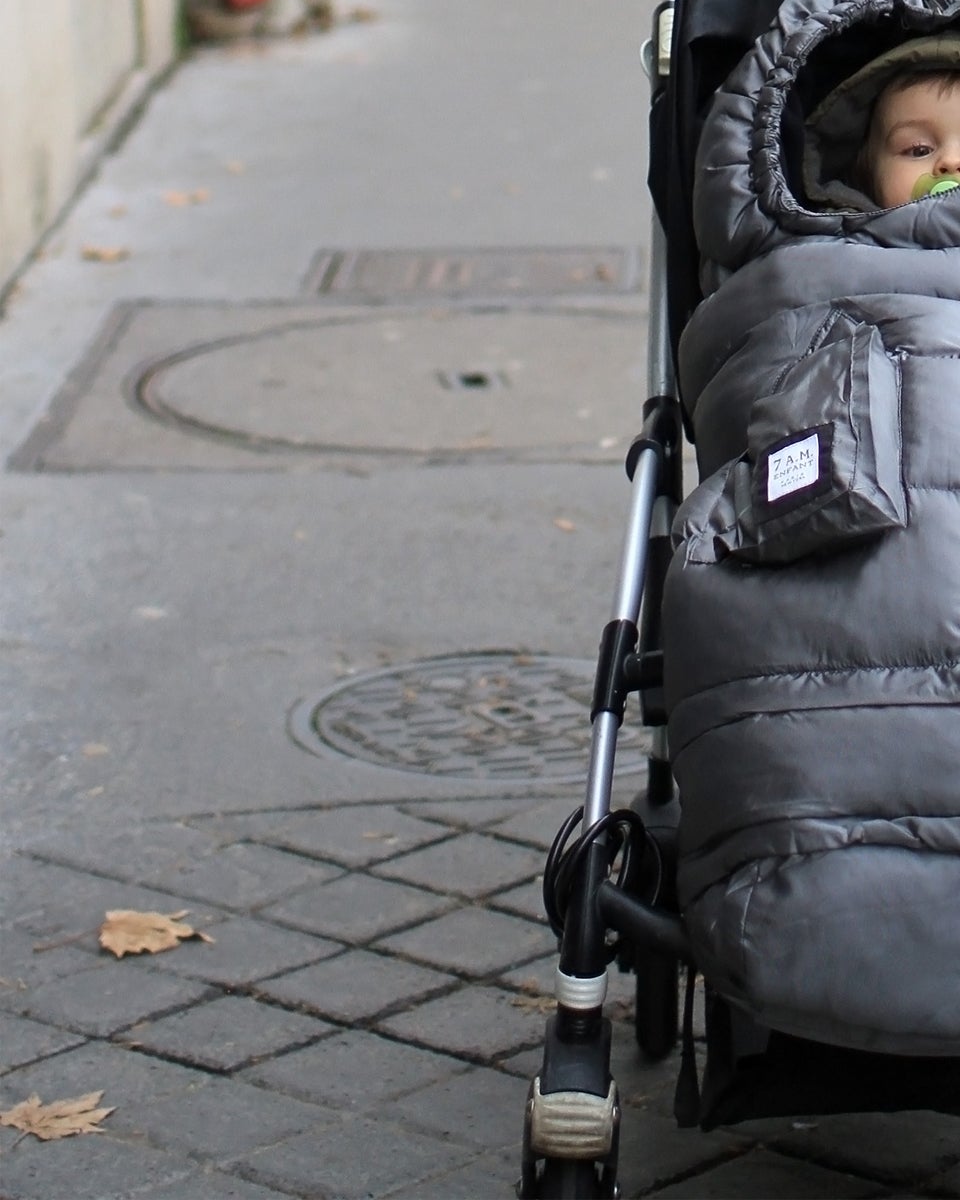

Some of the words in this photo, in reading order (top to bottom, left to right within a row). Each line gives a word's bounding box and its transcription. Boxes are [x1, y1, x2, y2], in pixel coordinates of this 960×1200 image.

[773, 459, 781, 471] 7
[786, 449, 813, 466] A.M.
[773, 459, 813, 480] ENFANT
